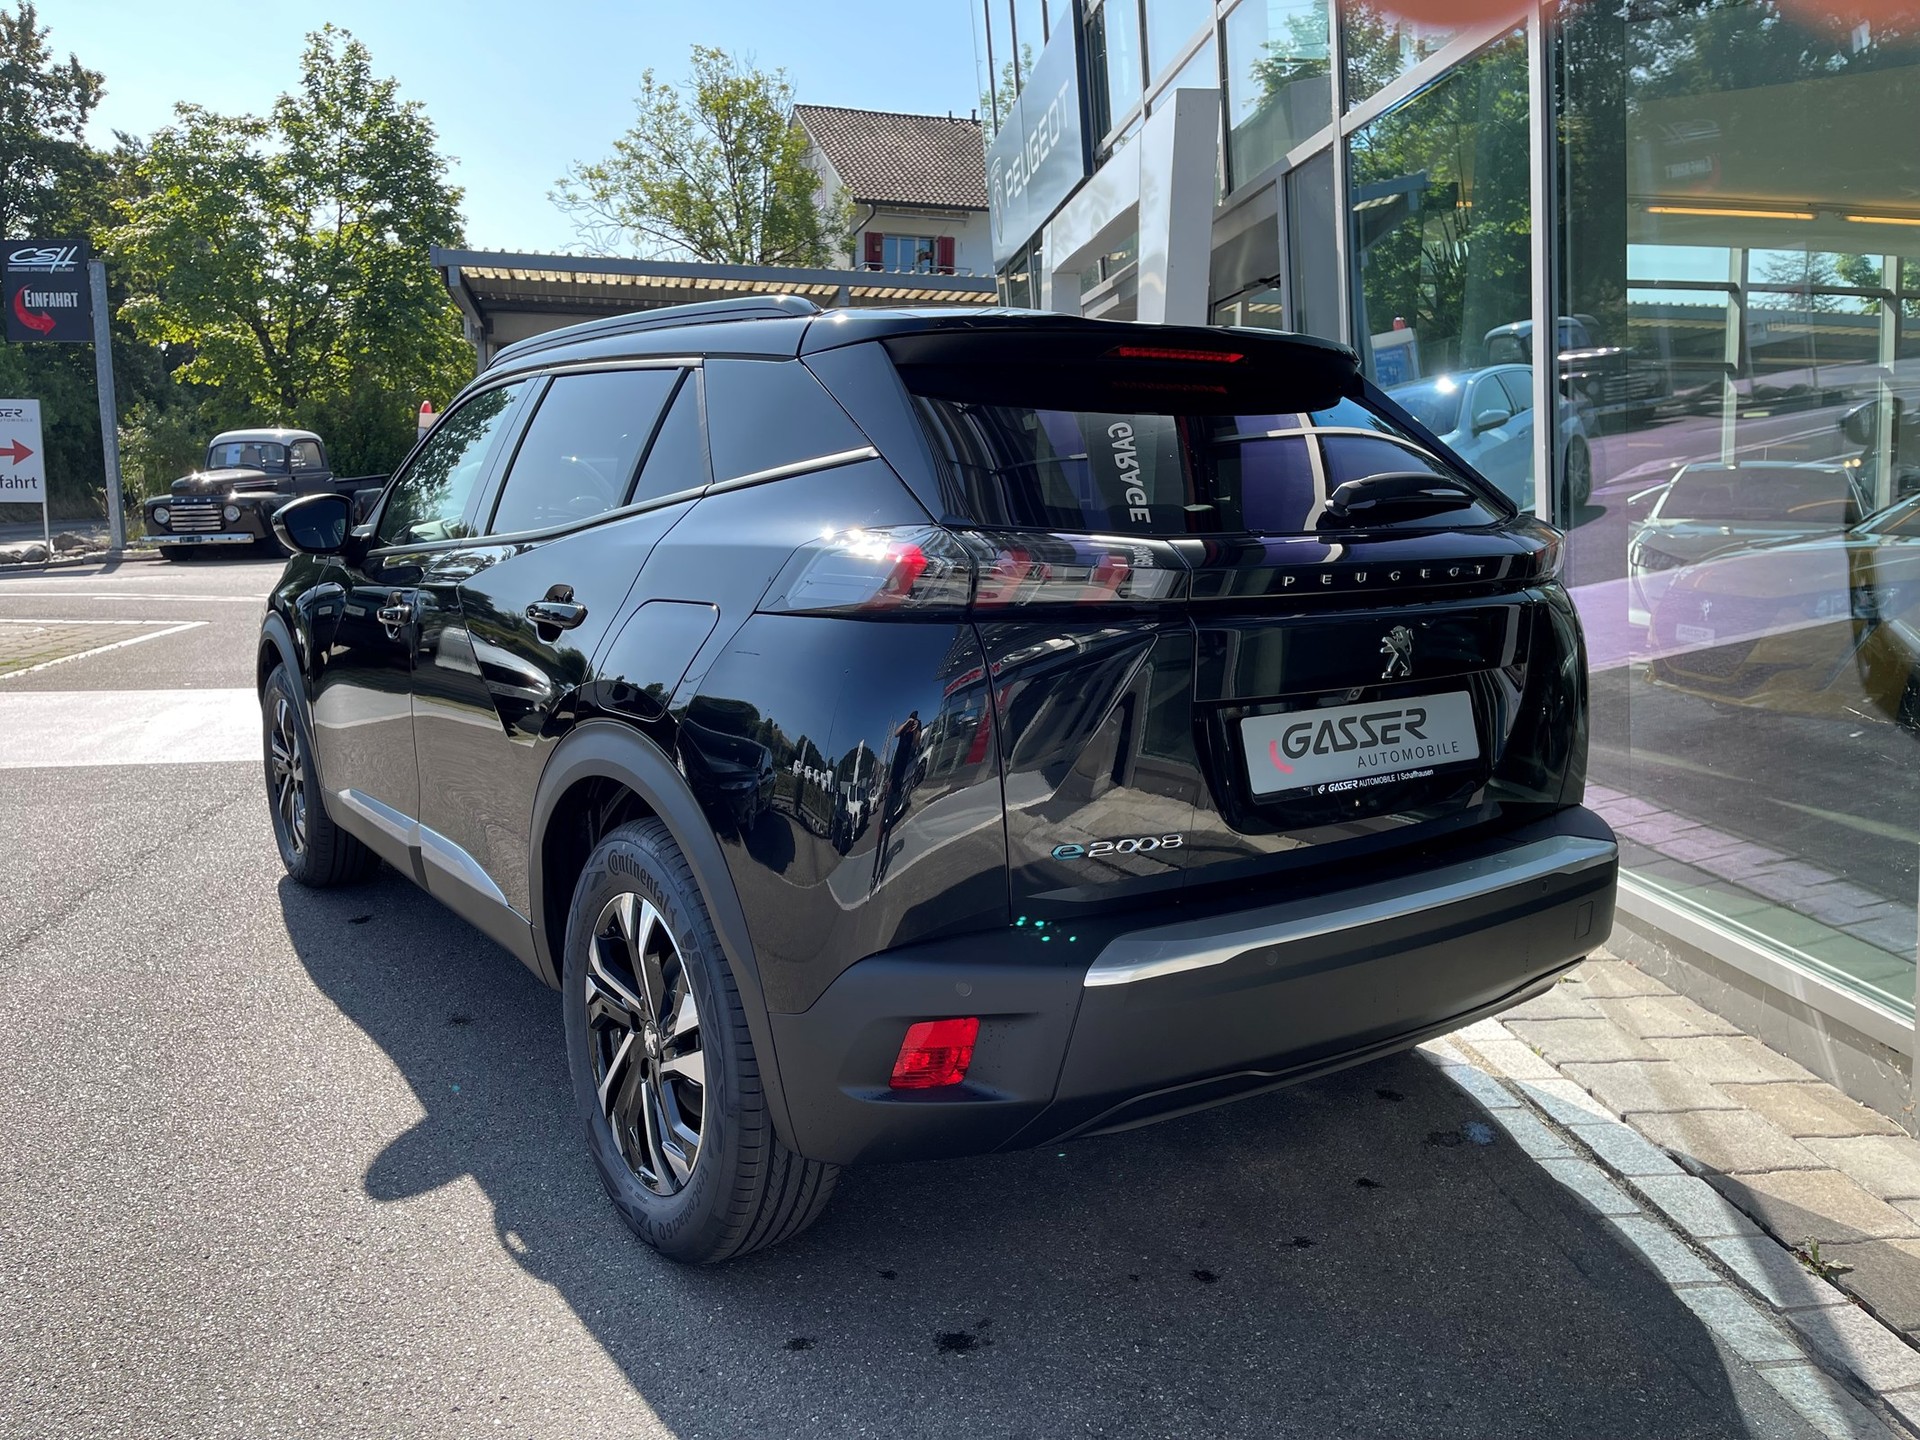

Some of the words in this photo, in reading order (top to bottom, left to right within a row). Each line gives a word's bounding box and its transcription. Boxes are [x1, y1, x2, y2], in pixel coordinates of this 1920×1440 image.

[1004, 79, 1069, 208] PEUGEOT
[1281, 564, 1485, 587] PEUGEOT
[1281, 707, 1428, 760] GASSER
[1357, 740, 1460, 769] AUTOMOBILE
[1328, 779, 1358, 792] GASSER
[1358, 773, 1396, 788] AUTOMOBILE
[1400, 768, 1434, 781] Schaffhausen
[607, 849, 671, 916] Continental
